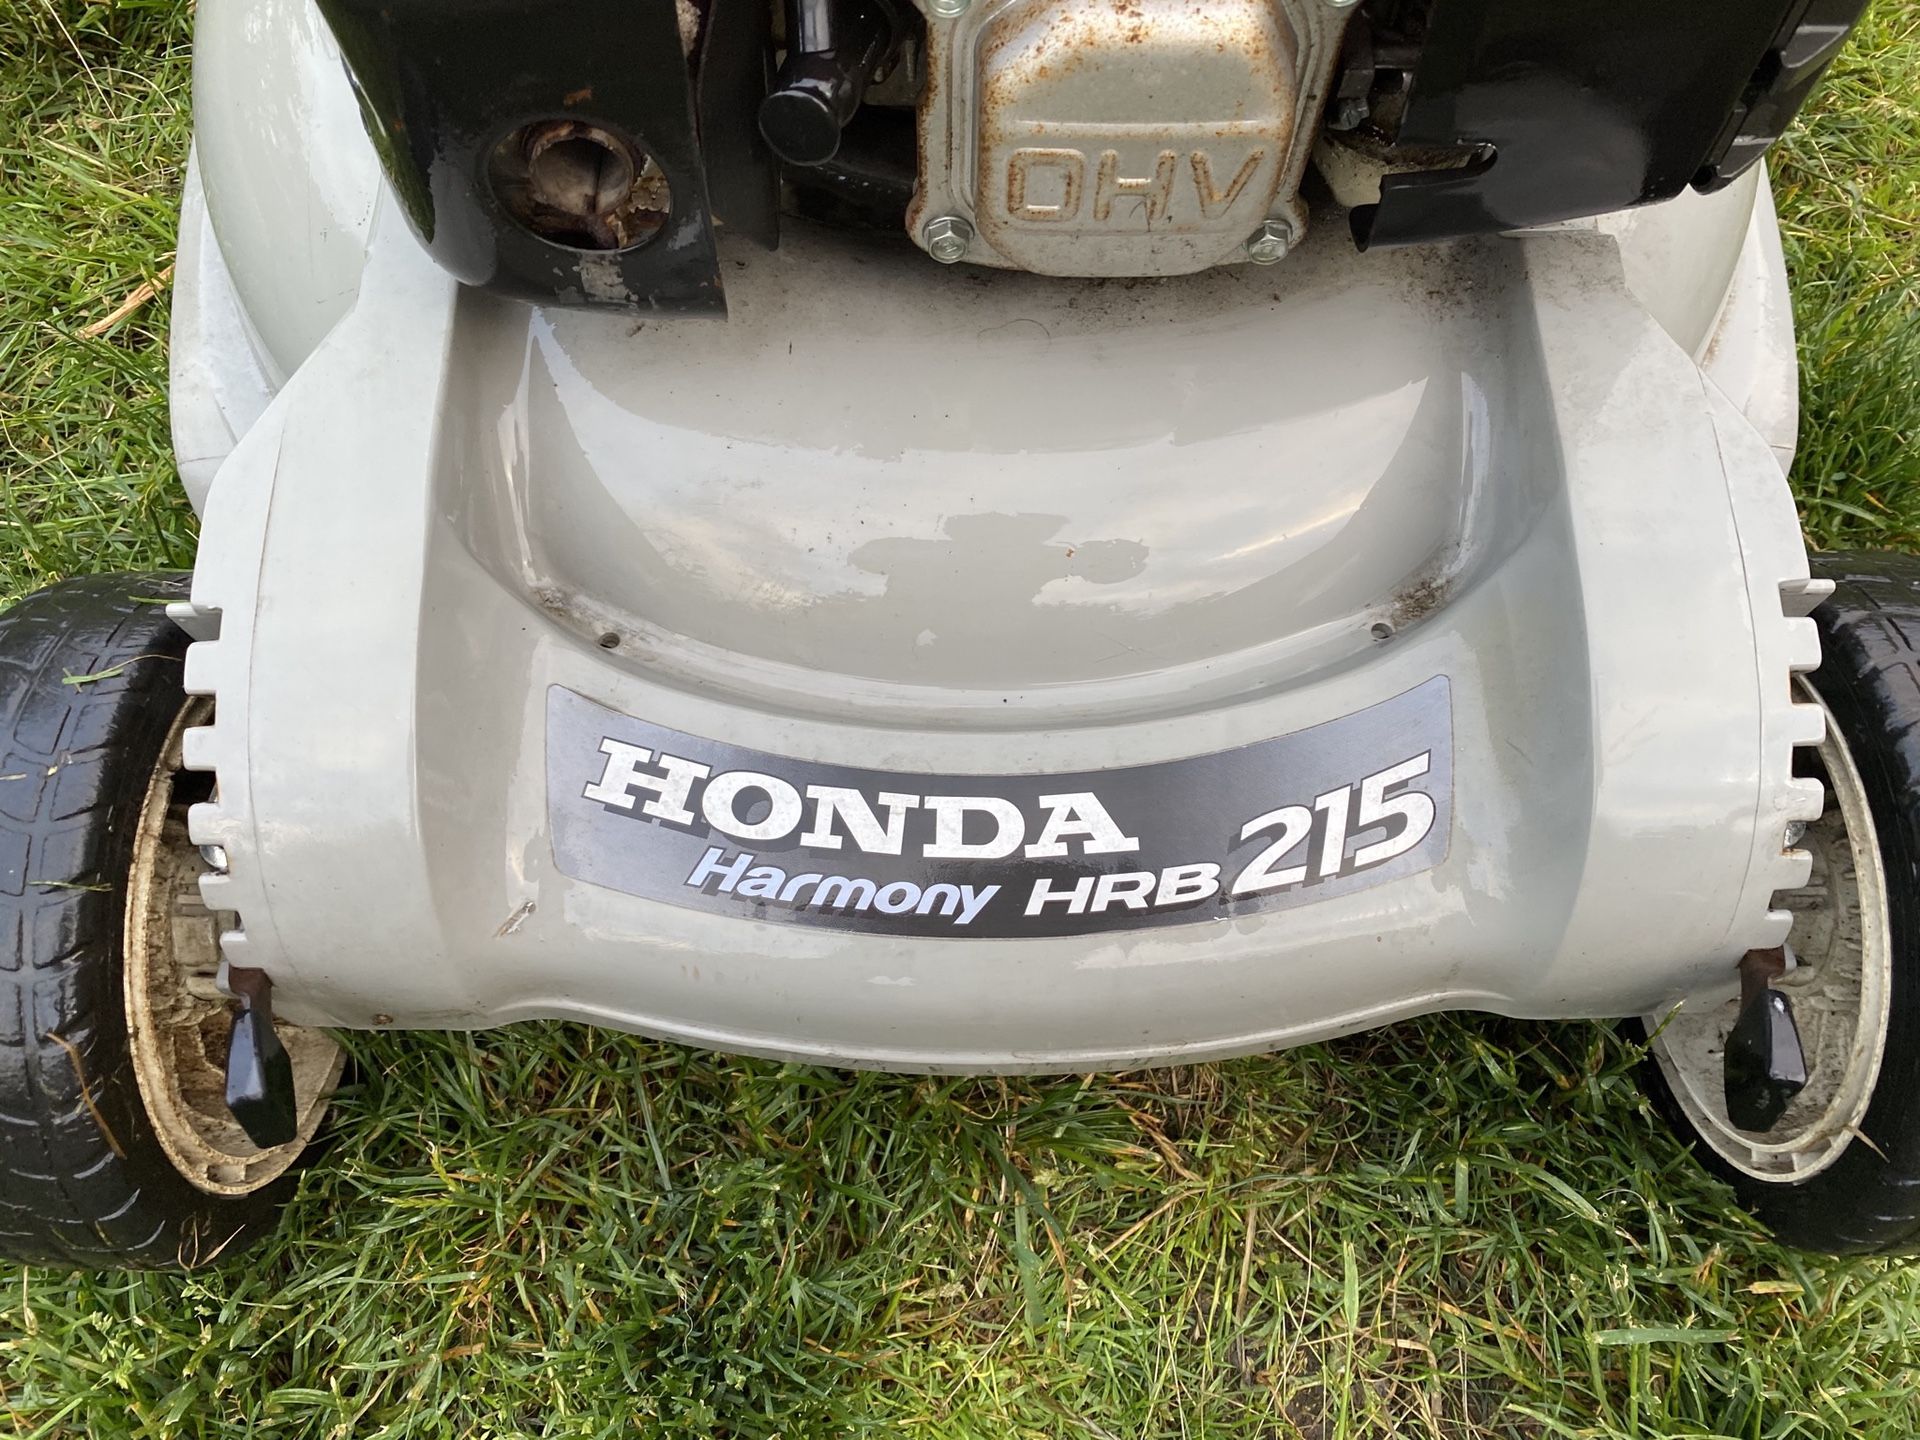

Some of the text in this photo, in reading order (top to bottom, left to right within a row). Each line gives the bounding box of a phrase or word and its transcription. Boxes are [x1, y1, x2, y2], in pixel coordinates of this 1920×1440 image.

[1008, 148, 1265, 221] OHV
[583, 738, 1140, 860] HONDA
[687, 751, 1437, 925] Harmony HRB 215
